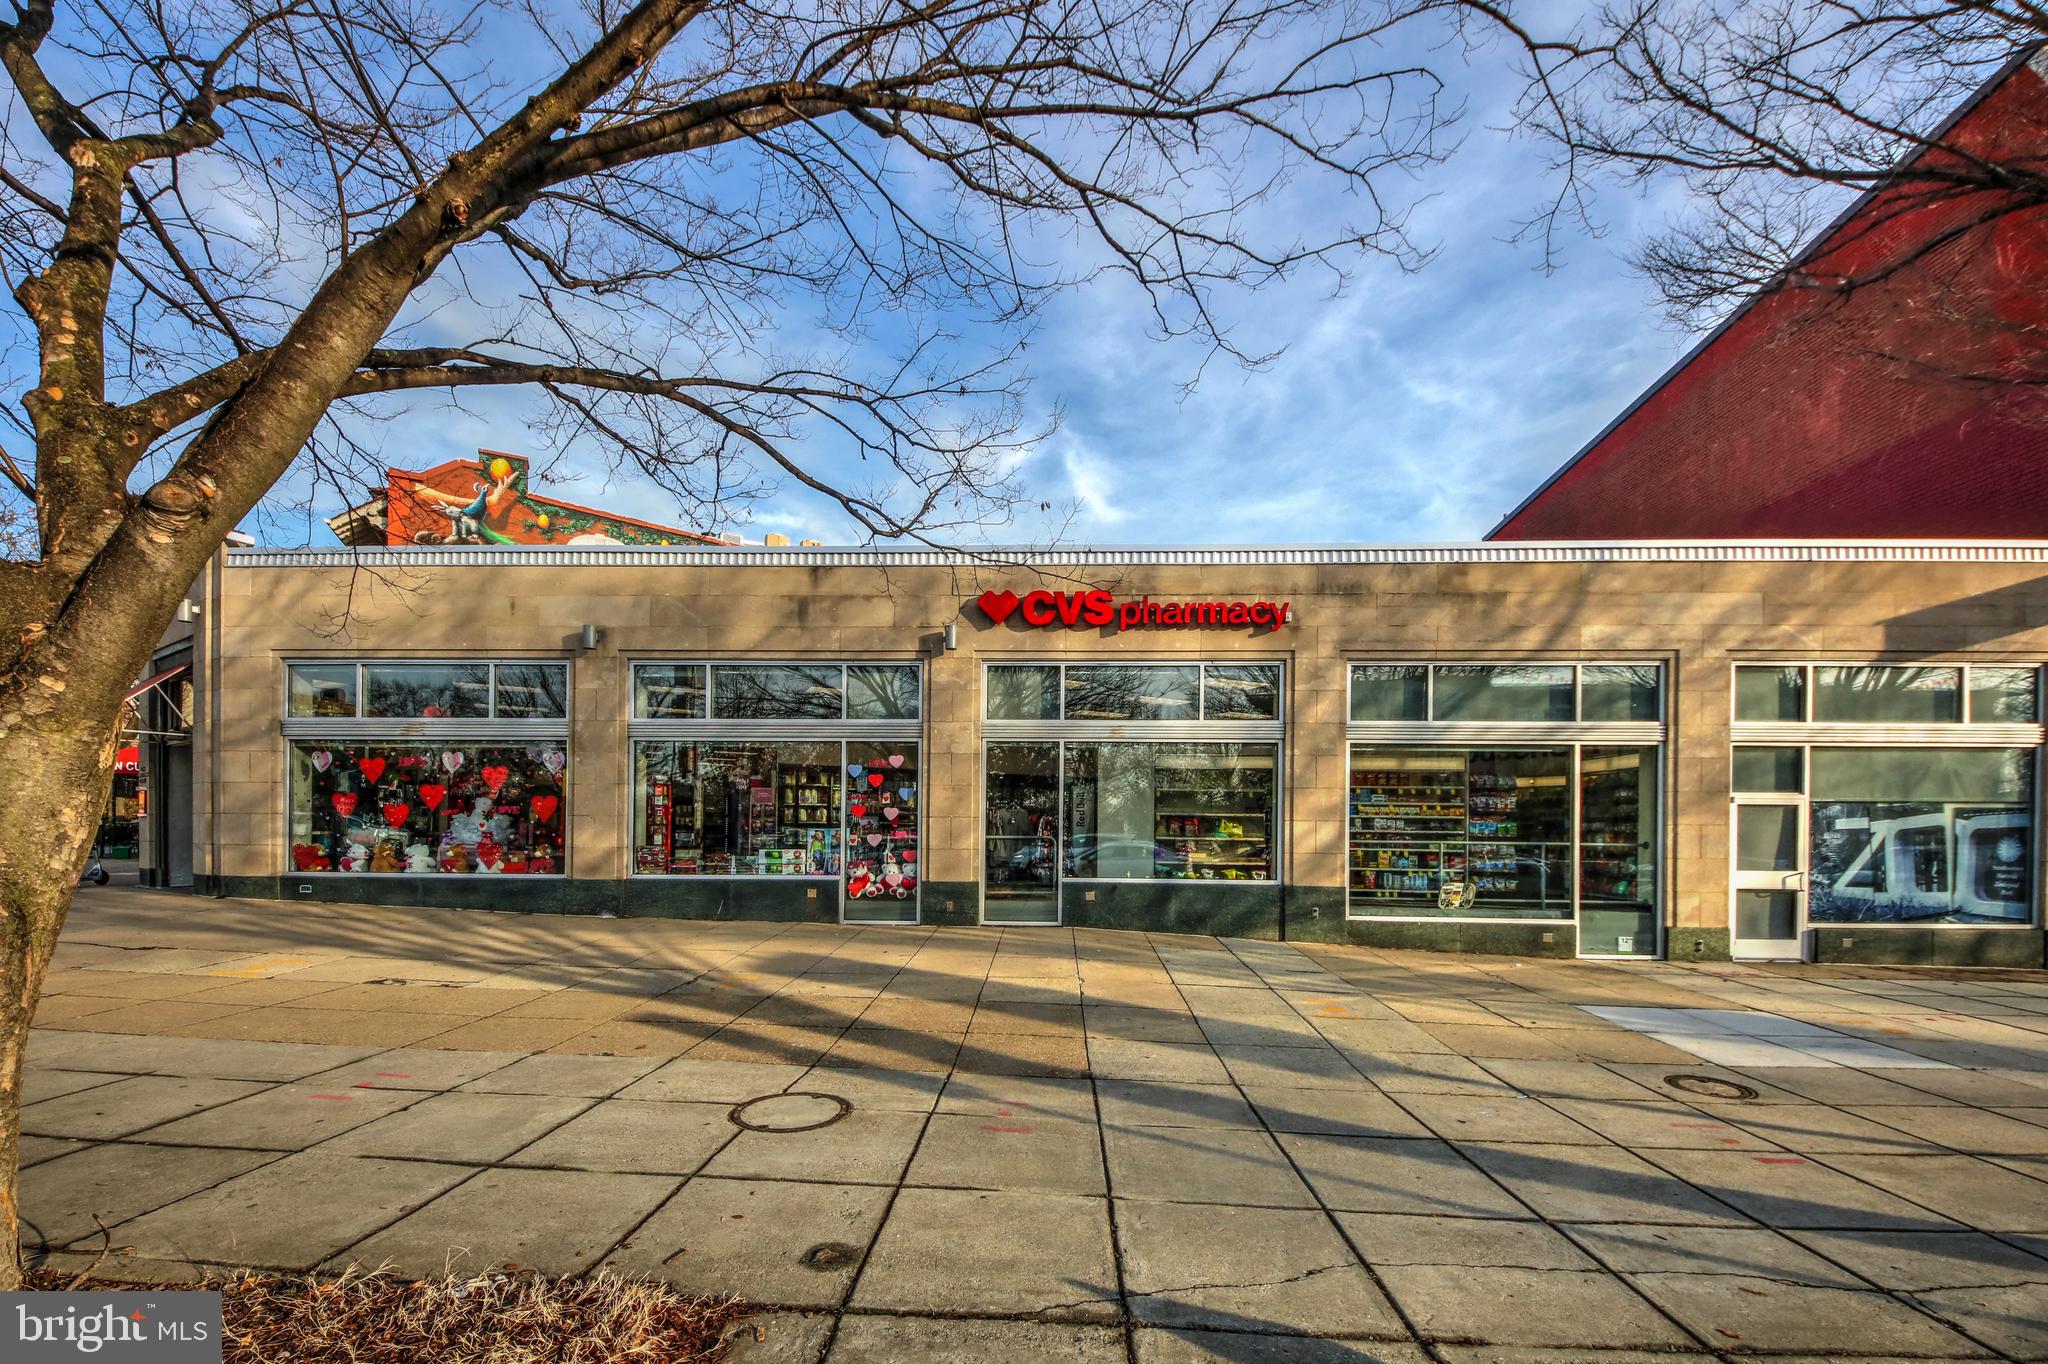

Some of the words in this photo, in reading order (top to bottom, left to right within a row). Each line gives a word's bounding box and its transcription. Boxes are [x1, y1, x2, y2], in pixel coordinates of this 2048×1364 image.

[1022, 590, 1114, 625] CVS
[1120, 595, 1290, 631] pharmacy
[1076, 809, 1085, 827] Red
